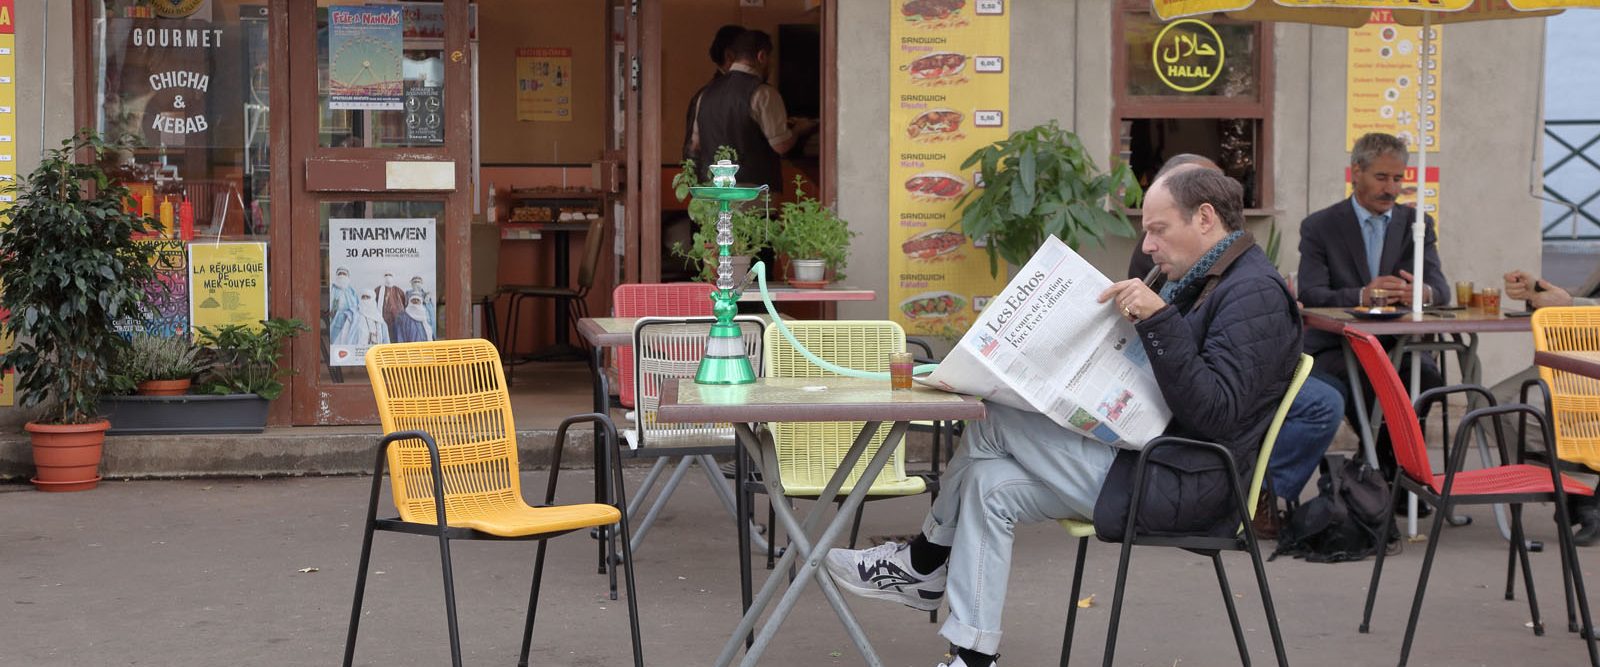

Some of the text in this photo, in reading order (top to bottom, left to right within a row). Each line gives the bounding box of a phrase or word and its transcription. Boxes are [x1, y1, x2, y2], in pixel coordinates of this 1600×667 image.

[133, 28, 223, 47] GOURMET
[1163, 32, 1217, 63] حلال
[1168, 65, 1211, 77] HALAL
[149, 70, 209, 93] CHICHA
[173, 95, 186, 108] &
[151, 114, 208, 134] KEBAB
[340, 227, 427, 241] TINARIWEN
[346, 248, 384, 258] 30 APR
[193, 262, 264, 274] LA RÉPUBLIQUE
[218, 272, 230, 281] DE
[986, 270, 1046, 335] Les Echos
[1004, 331, 1016, 343] Le
[1015, 312, 1033, 333] cours
[1038, 276, 1064, 305] l'action
[1011, 328, 1029, 349] Porc
